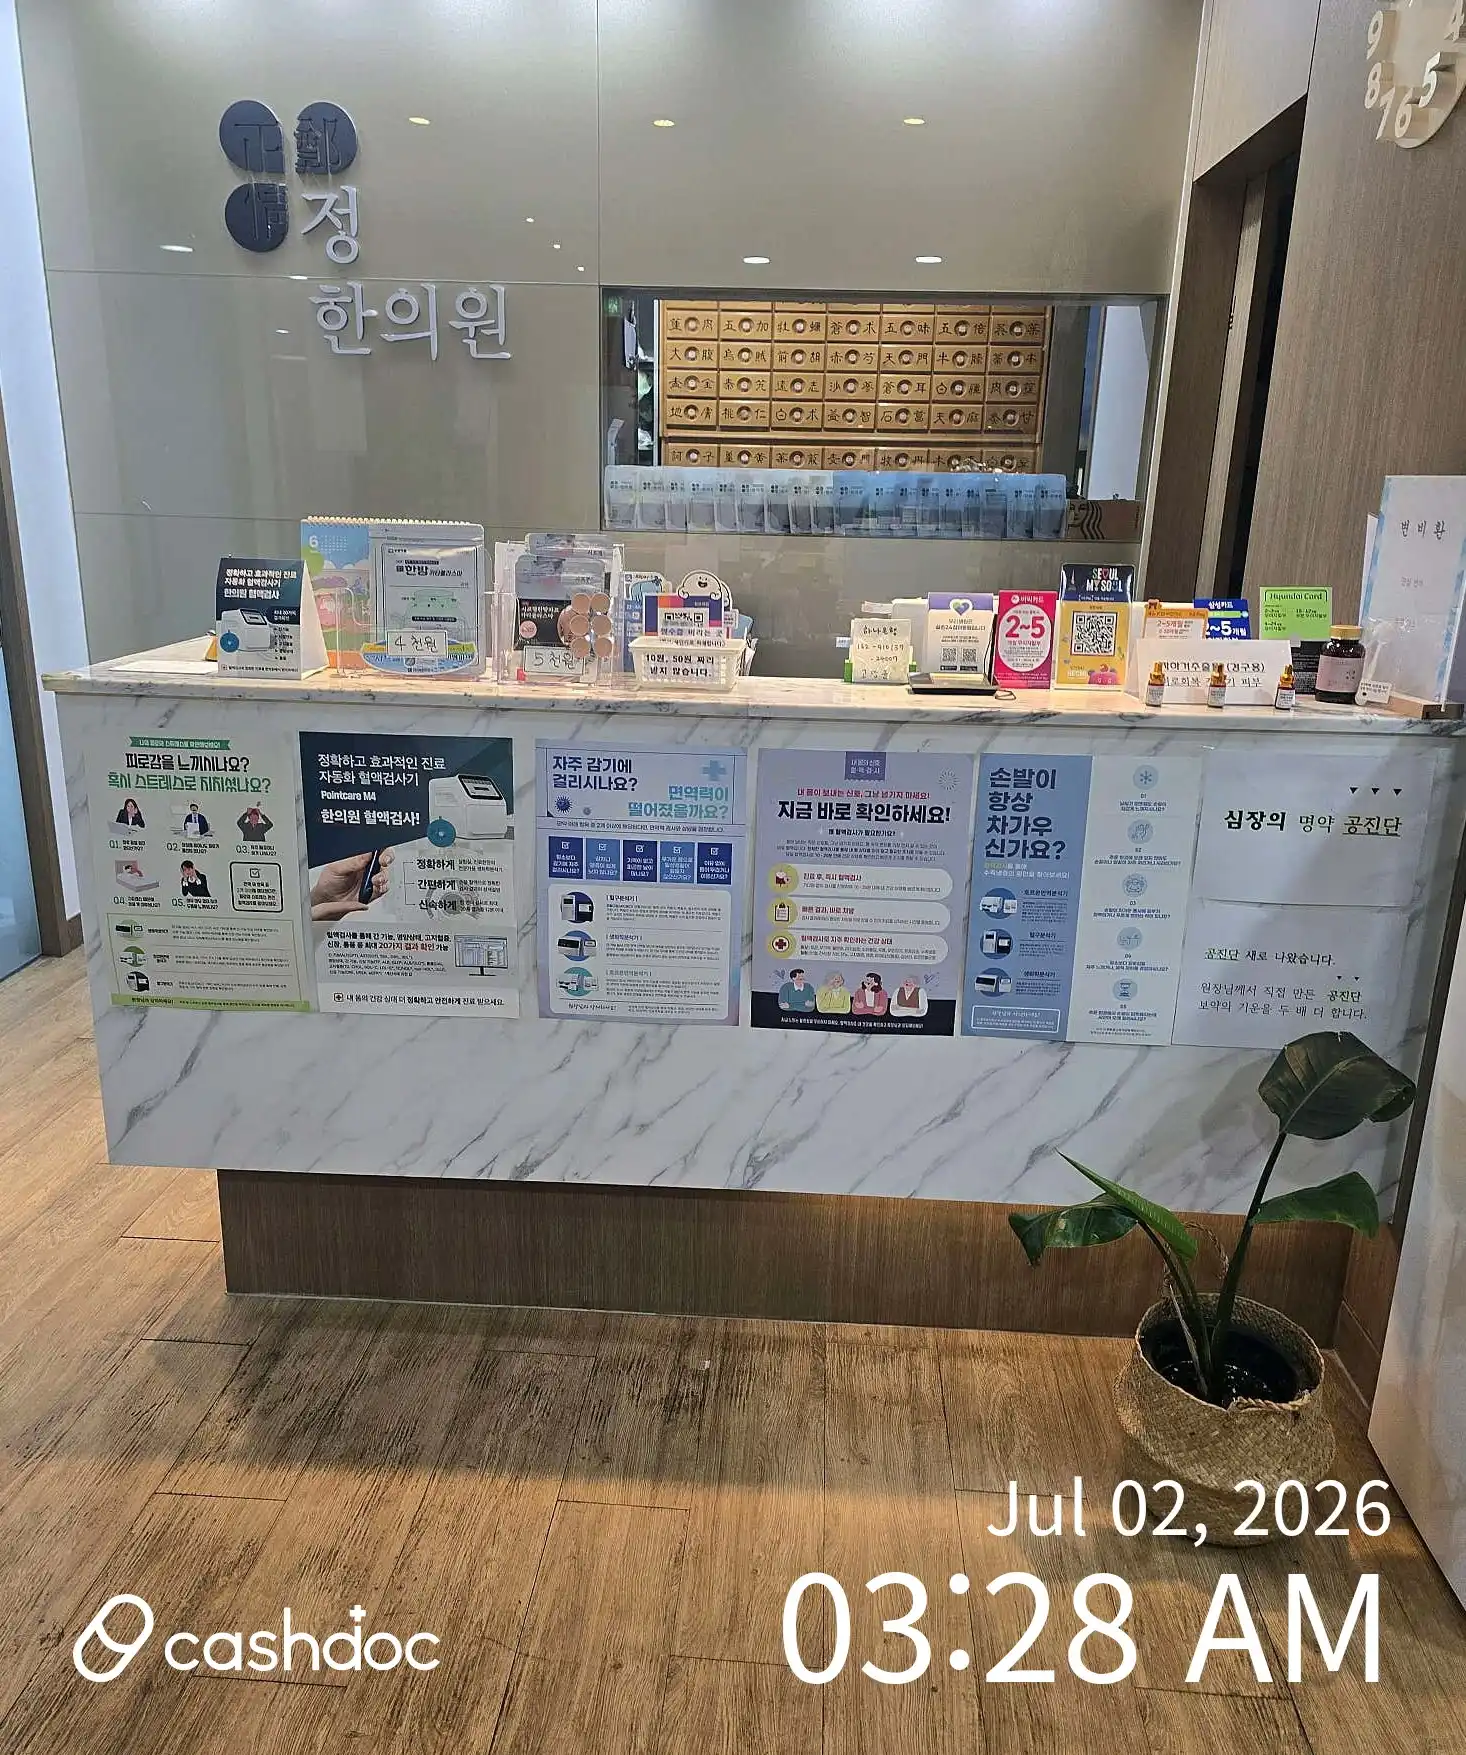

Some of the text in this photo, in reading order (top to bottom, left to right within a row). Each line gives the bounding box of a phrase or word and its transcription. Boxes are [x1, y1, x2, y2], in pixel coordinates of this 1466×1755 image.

[301, 185, 358, 264] 정
[309, 281, 511, 360] 한의원
[308, 535, 319, 548] 6
[1086, 579, 1123, 592] MY SOUL
[1270, 592, 1323, 600] Hyundai Card
[1208, 601, 1234, 610] 삼성카드
[1005, 615, 1046, 639] 2~5
[395, 635, 438, 653] 4 천원
[534, 651, 575, 670] 5 천원
[646, 654, 715, 665] 10원, 50원 짜리
[650, 666, 712, 677] 받지 않습니다.
[125, 752, 250, 773] 피로감을 느끼시나요?
[318, 753, 446, 771] 정확하고 효과적인 진료
[552, 756, 632, 774] 자주 감기에
[108, 771, 272, 793] 혹시 스트레스로 지치셨나요?
[318, 770, 419, 786] 자동화 혈액검사기
[552, 774, 638, 792] 걸리시나요?
[989, 767, 1057, 789] 손발이
[320, 790, 377, 801] Pointcare M4
[668, 785, 729, 801] 면역력이
[797, 788, 804, 796] 내
[806, 788, 821, 797] 몸이
[822, 789, 845, 797] 보내는
[864, 790, 880, 799] 그냥
[988, 791, 1033, 813] 항상
[320, 809, 420, 826] 한의원 혈액검사!
[628, 801, 729, 820] 떨어졌을까요?
[778, 800, 950, 823] 지금 바로 확인하세요!
[986, 815, 1052, 837] 차가우
[1224, 810, 1402, 836] 심장의 명약 공진단
[984, 838, 1066, 860] 신가요?
[416, 858, 455, 871] 정확하게
[417, 878, 456, 891] 간편하게
[418, 899, 457, 911] 신속하게
[379, 942, 403, 951] 20가지
[1204, 947, 1336, 966] 공진단 새로 나왔습니다.
[1200, 981, 1362, 1003] 원장님께서 직접 만든 공진단
[1198, 1000, 1367, 1020] 보약의 기운을 두 배 더 합니다.
